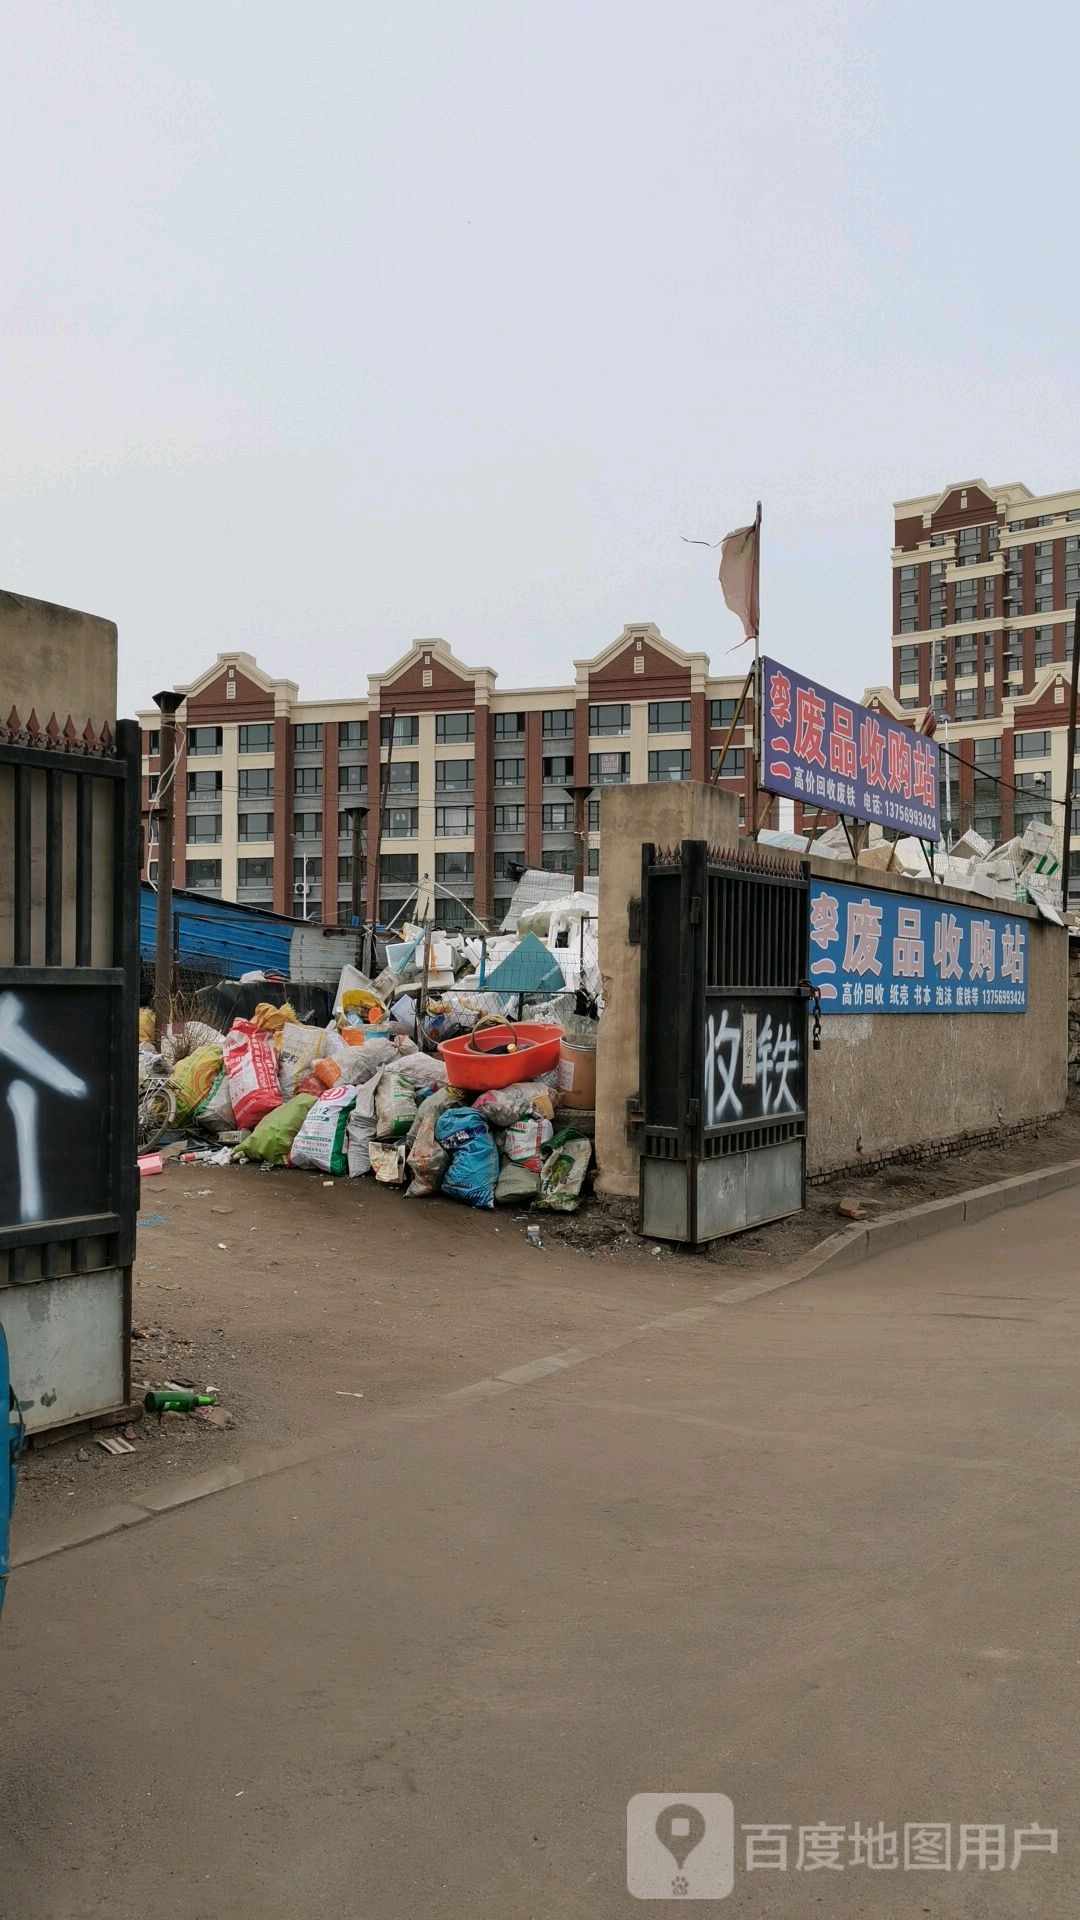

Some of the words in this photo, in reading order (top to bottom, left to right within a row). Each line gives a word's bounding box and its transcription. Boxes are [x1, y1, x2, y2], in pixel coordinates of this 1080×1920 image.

[770, 670, 792, 779] 李二
[794, 687, 936, 808] 废品收购站
[794, 766, 856, 808] 高价回收废铁
[810, 891, 839, 999] 李二
[842, 898, 1025, 983] 废品收购站
[842, 981, 885, 1005] 高价回收
[889, 983, 909, 1006] 纸壳
[914, 984, 931, 1005] 书本
[935, 985, 952, 1006] 泡沫
[956, 986, 979, 1006] 废铁等
[982, 988, 1025, 1005] 13756993424
